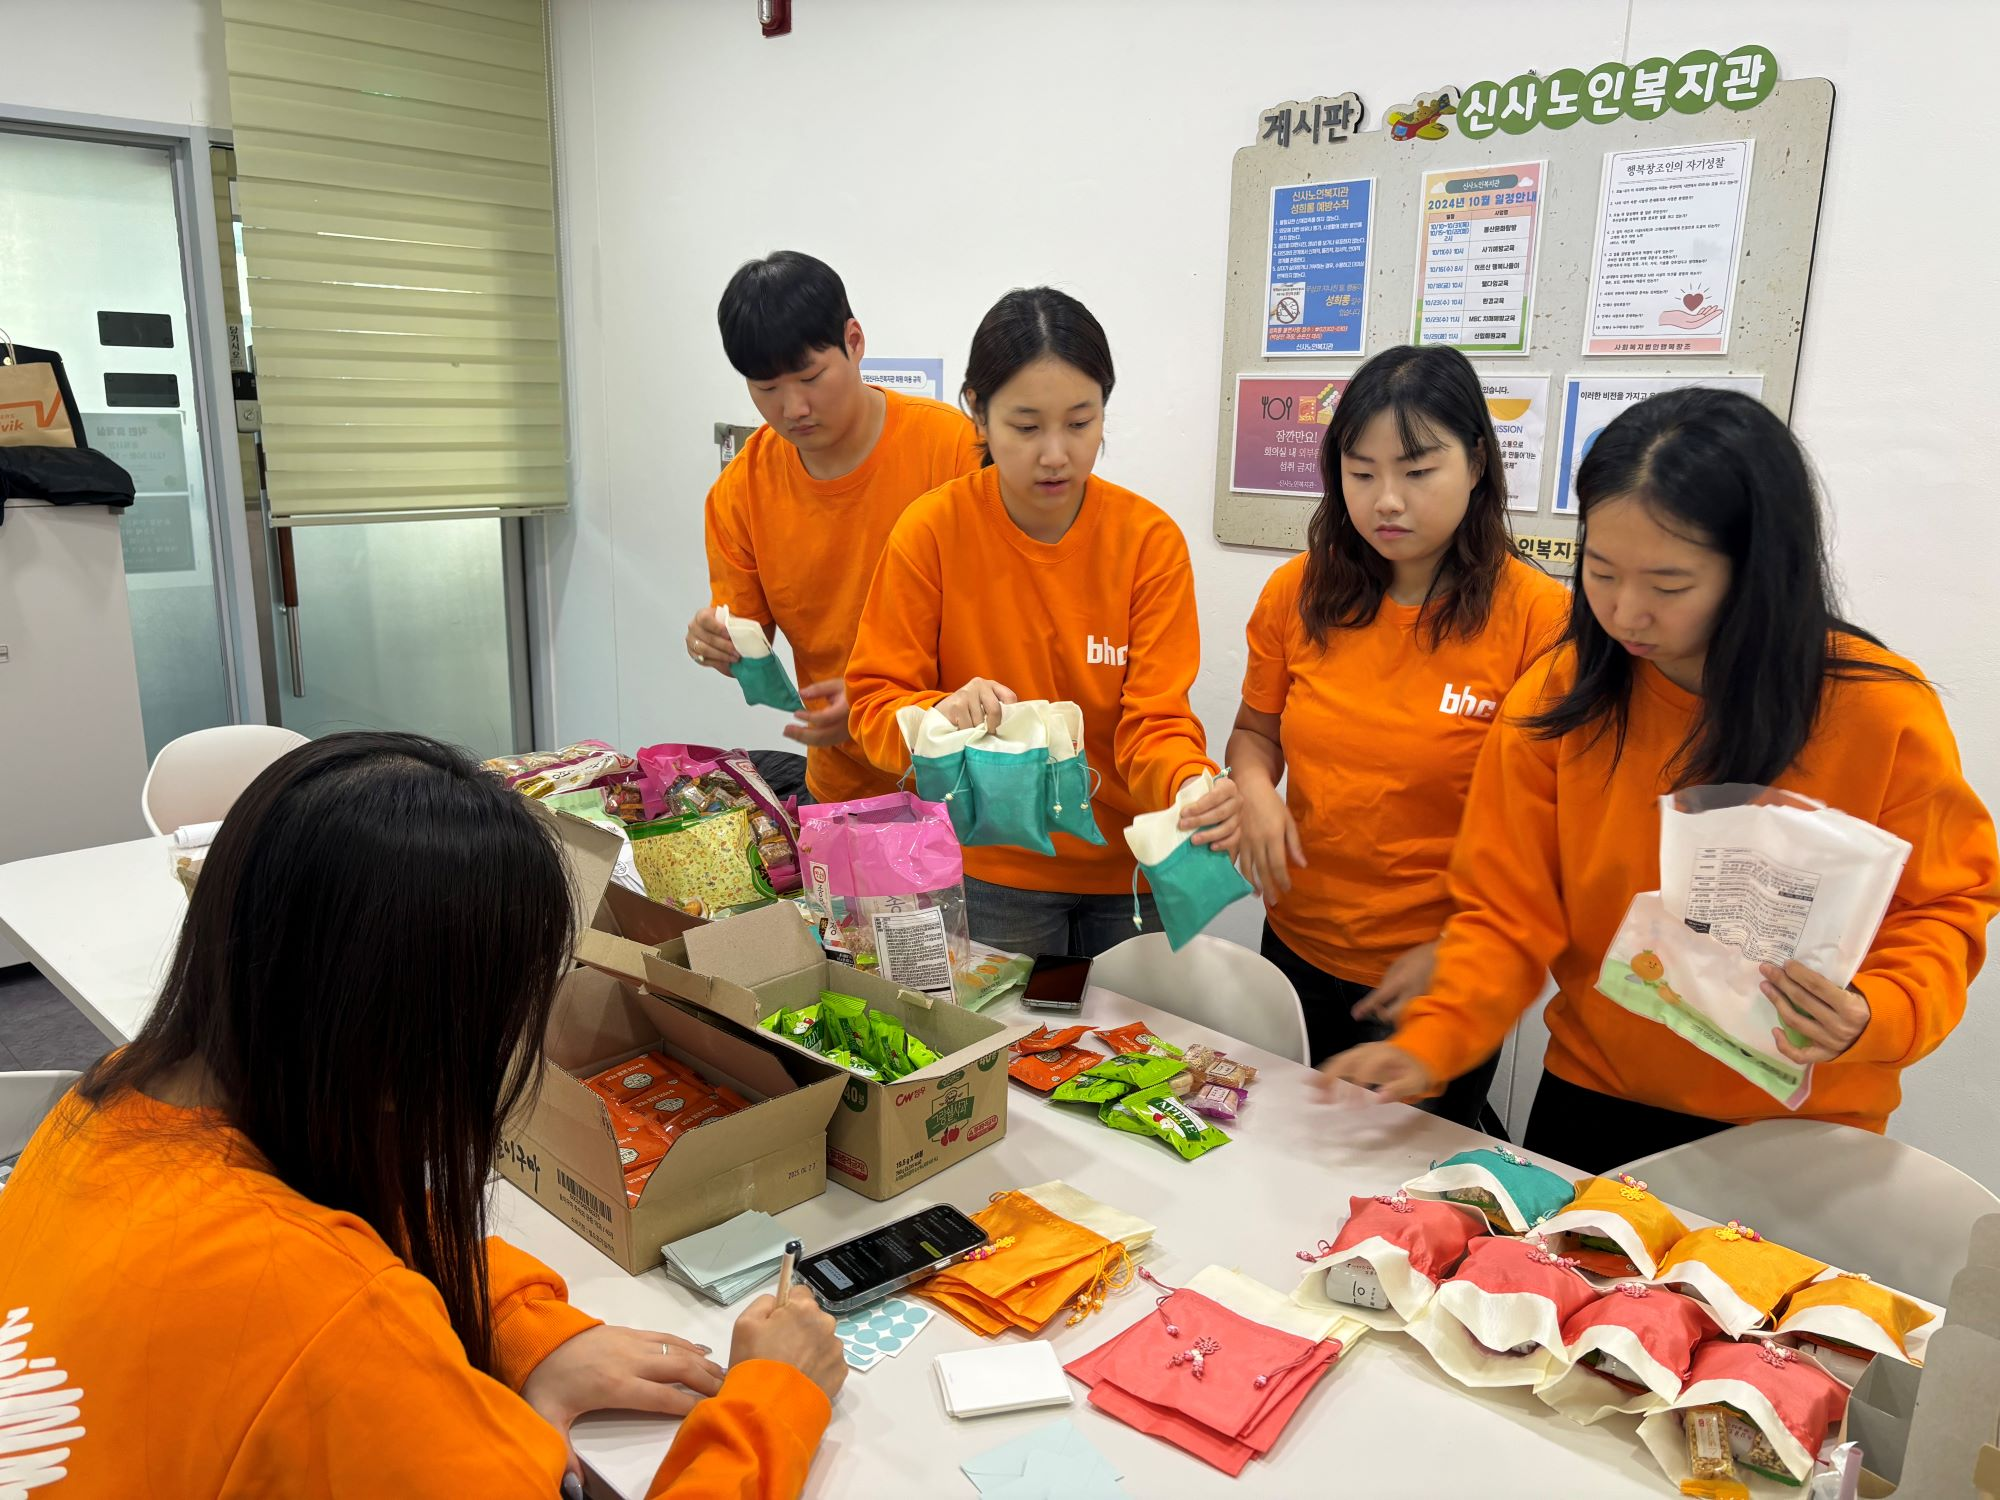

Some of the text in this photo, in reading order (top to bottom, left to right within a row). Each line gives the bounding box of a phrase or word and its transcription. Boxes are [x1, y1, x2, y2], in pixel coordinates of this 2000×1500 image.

[1462, 54, 1767, 132] 신사노인복지관
[1262, 100, 1355, 147] 게시판
[1627, 157, 1726, 177] 행복창조인의 자기성찰
[1462, 179, 1500, 191] 신사노인복지관
[1292, 186, 1349, 202] 신사노인복지관
[1428, 191, 1537, 210] 2024년 10월 일정안내
[1291, 199, 1349, 214] 성희롱 예방수칙
[1481, 244, 1515, 253] 사기예방교육
[1326, 294, 1351, 306] 성희롱
[229, 325, 240, 359] 당기시오
[1580, 391, 1601, 400] 이러한
[1603, 391, 1624, 401] 비전을
[1625, 391, 1647, 400] 가지고
[0, 419, 25, 432] vik
[1275, 430, 1318, 443] 잠깐만요!
[1263, 446, 1287, 458] 회의실
[1288, 447, 1297, 457] 내
[1279, 461, 1316, 473] 섭취 금지!
[1087, 634, 1129, 666] bhc
[1439, 682, 1497, 718] bhc
[1155, 1101, 1198, 1134] APPLE
